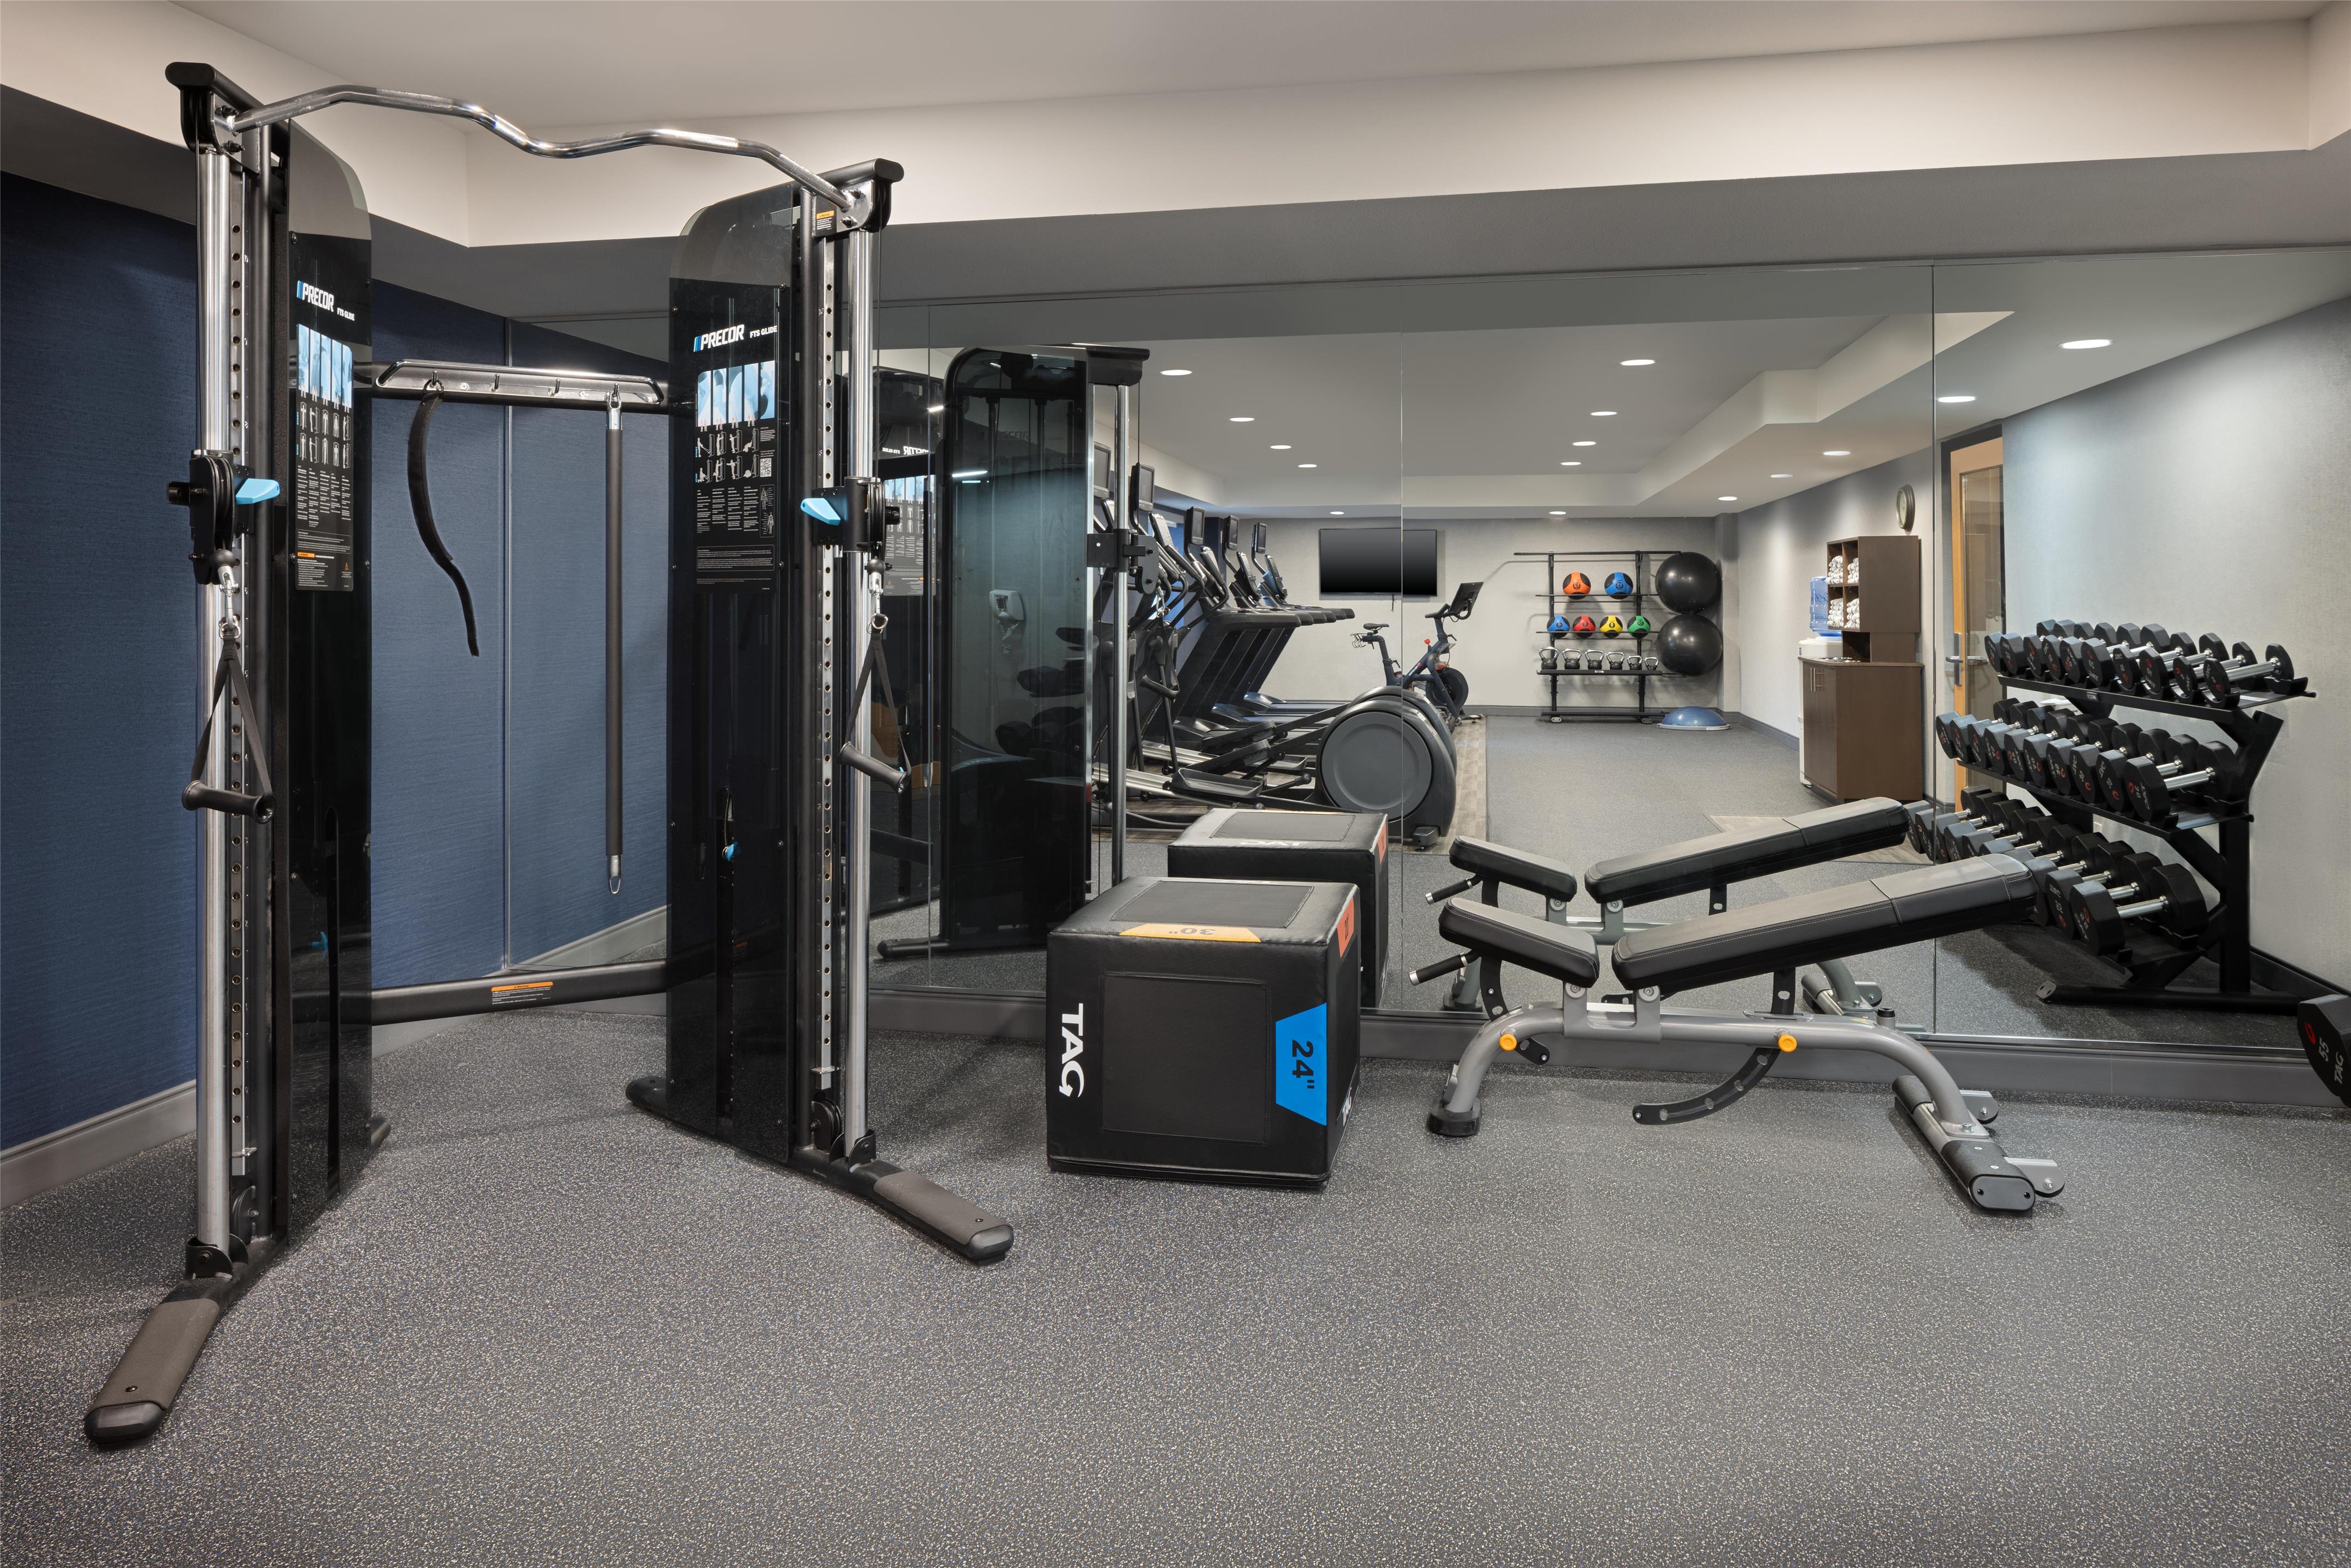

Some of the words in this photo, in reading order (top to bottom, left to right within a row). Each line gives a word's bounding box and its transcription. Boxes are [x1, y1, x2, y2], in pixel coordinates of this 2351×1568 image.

[302, 283, 334, 312] PRECOR
[344, 310, 355, 321] GLIDE
[700, 324, 744, 351] PRECOR
[750, 330, 760, 339] FTS
[761, 326, 778, 335] GLIDE
[1059, 1003, 1084, 1097] TAG
[1292, 1040, 1314, 1088] 24"
[2318, 1037, 2329, 1062] 55
[2335, 1051, 2344, 1085] TAG
[1342, 1087, 1352, 1126] TAG
